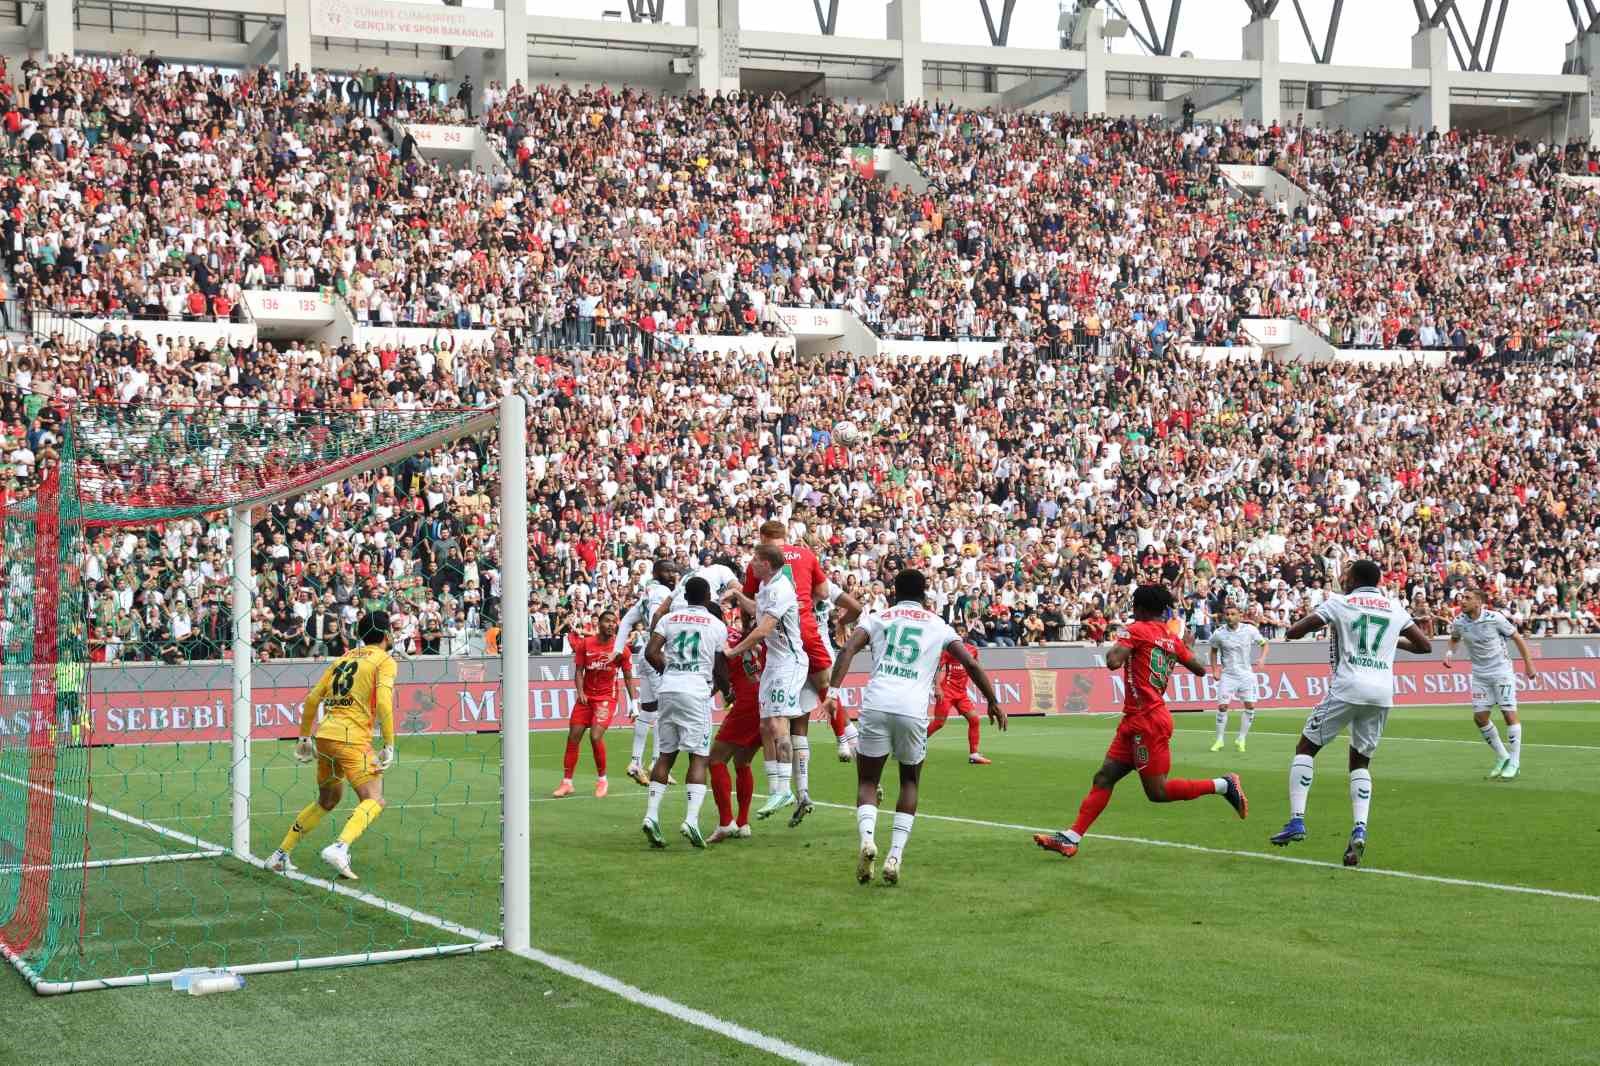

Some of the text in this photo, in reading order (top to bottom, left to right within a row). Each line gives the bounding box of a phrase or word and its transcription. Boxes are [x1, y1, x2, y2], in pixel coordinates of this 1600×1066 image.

[400, 23, 411, 33] VE
[414, 24, 440, 34] SPOR
[262, 299, 316, 311] 136 135
[672, 630, 700, 659] 11
[884, 624, 923, 664] 15
[1351, 612, 1390, 656] 17
[332, 661, 358, 696] 13
[877, 662, 918, 680] AWAZIEM
[106, 700, 226, 731] SEBEBİ
